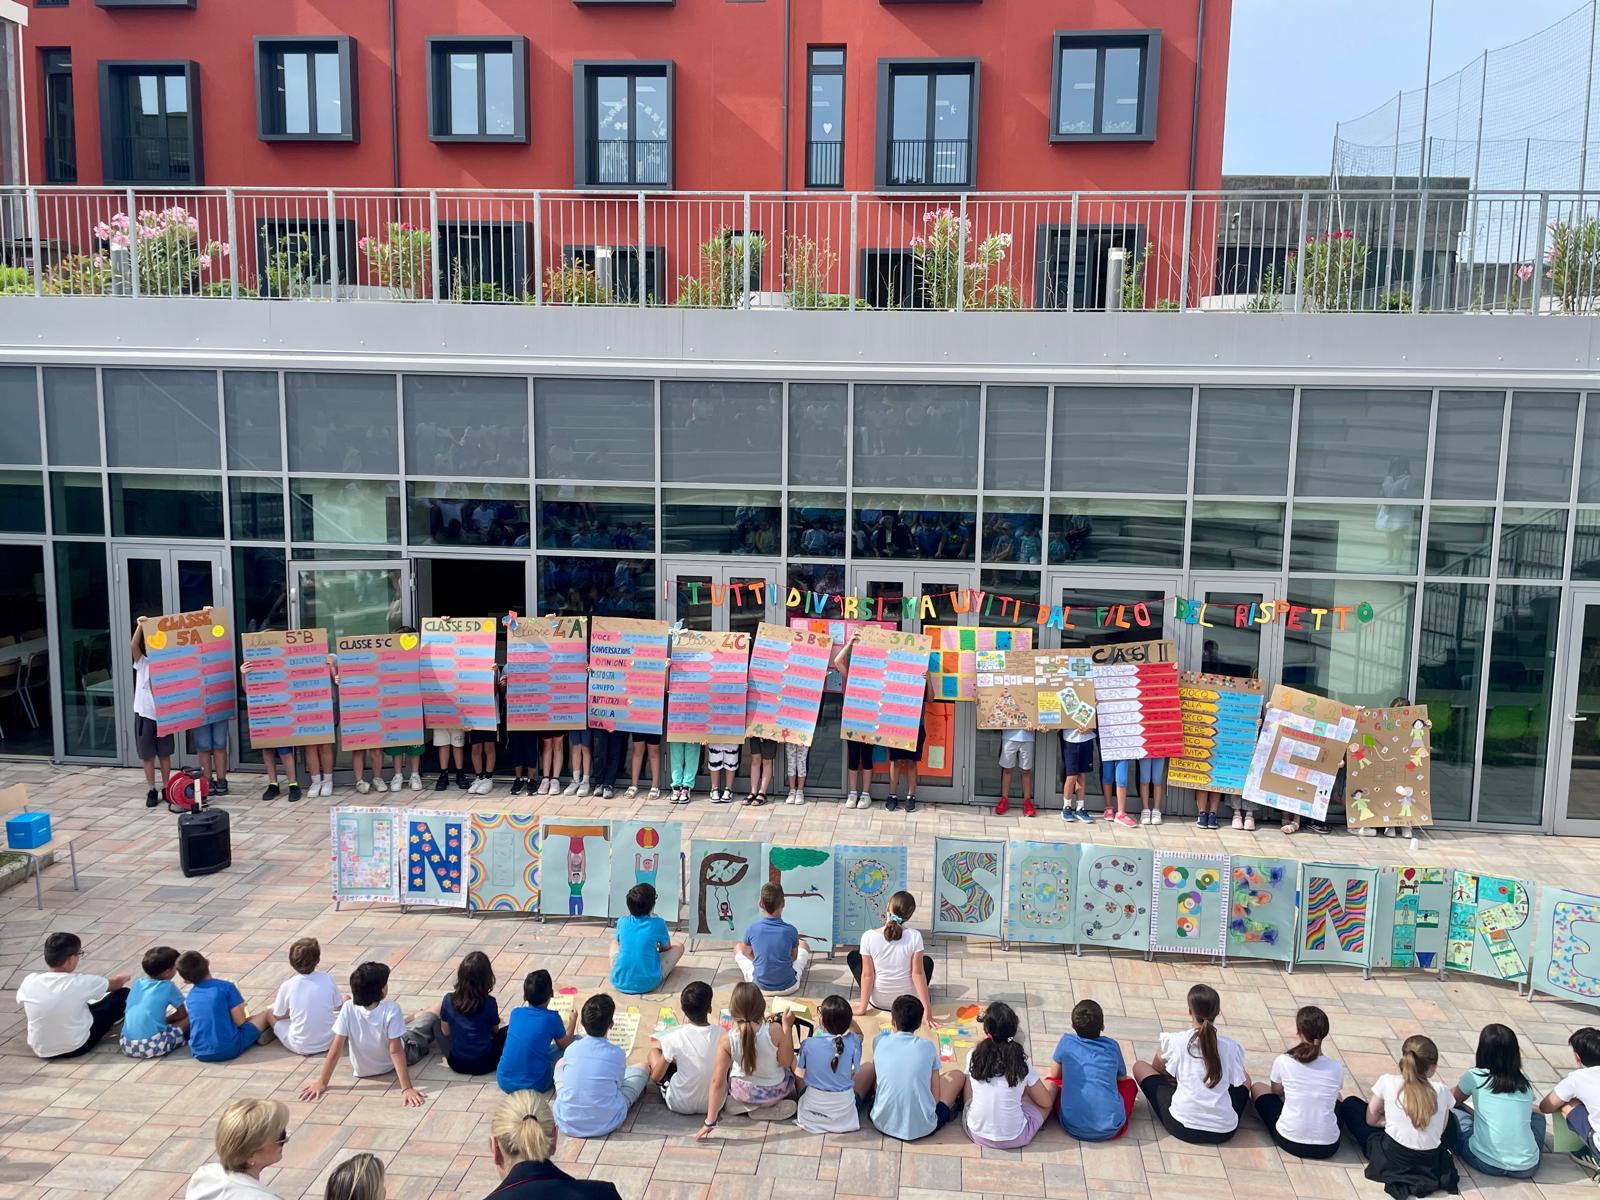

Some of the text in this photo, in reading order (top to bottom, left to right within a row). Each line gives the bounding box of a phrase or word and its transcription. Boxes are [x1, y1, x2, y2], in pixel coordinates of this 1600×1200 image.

[688, 582, 777, 606] TUTTI
[902, 595, 936, 620] MA
[1036, 604, 1075, 630] DAL
[1096, 601, 1151, 629] FILO
[1174, 596, 1214, 628] DEL
[1235, 600, 1374, 632] RISPETTO
[158, 610, 212, 632] CLASSE
[424, 620, 462, 632] CLASSE
[339, 638, 372, 650] CLASSE
[1179, 689, 1209, 698] GIOCO
[1181, 701, 1202, 709] ALLA
[1182, 713, 1203, 721] ARCO
[1183, 725, 1204, 733] DERE
